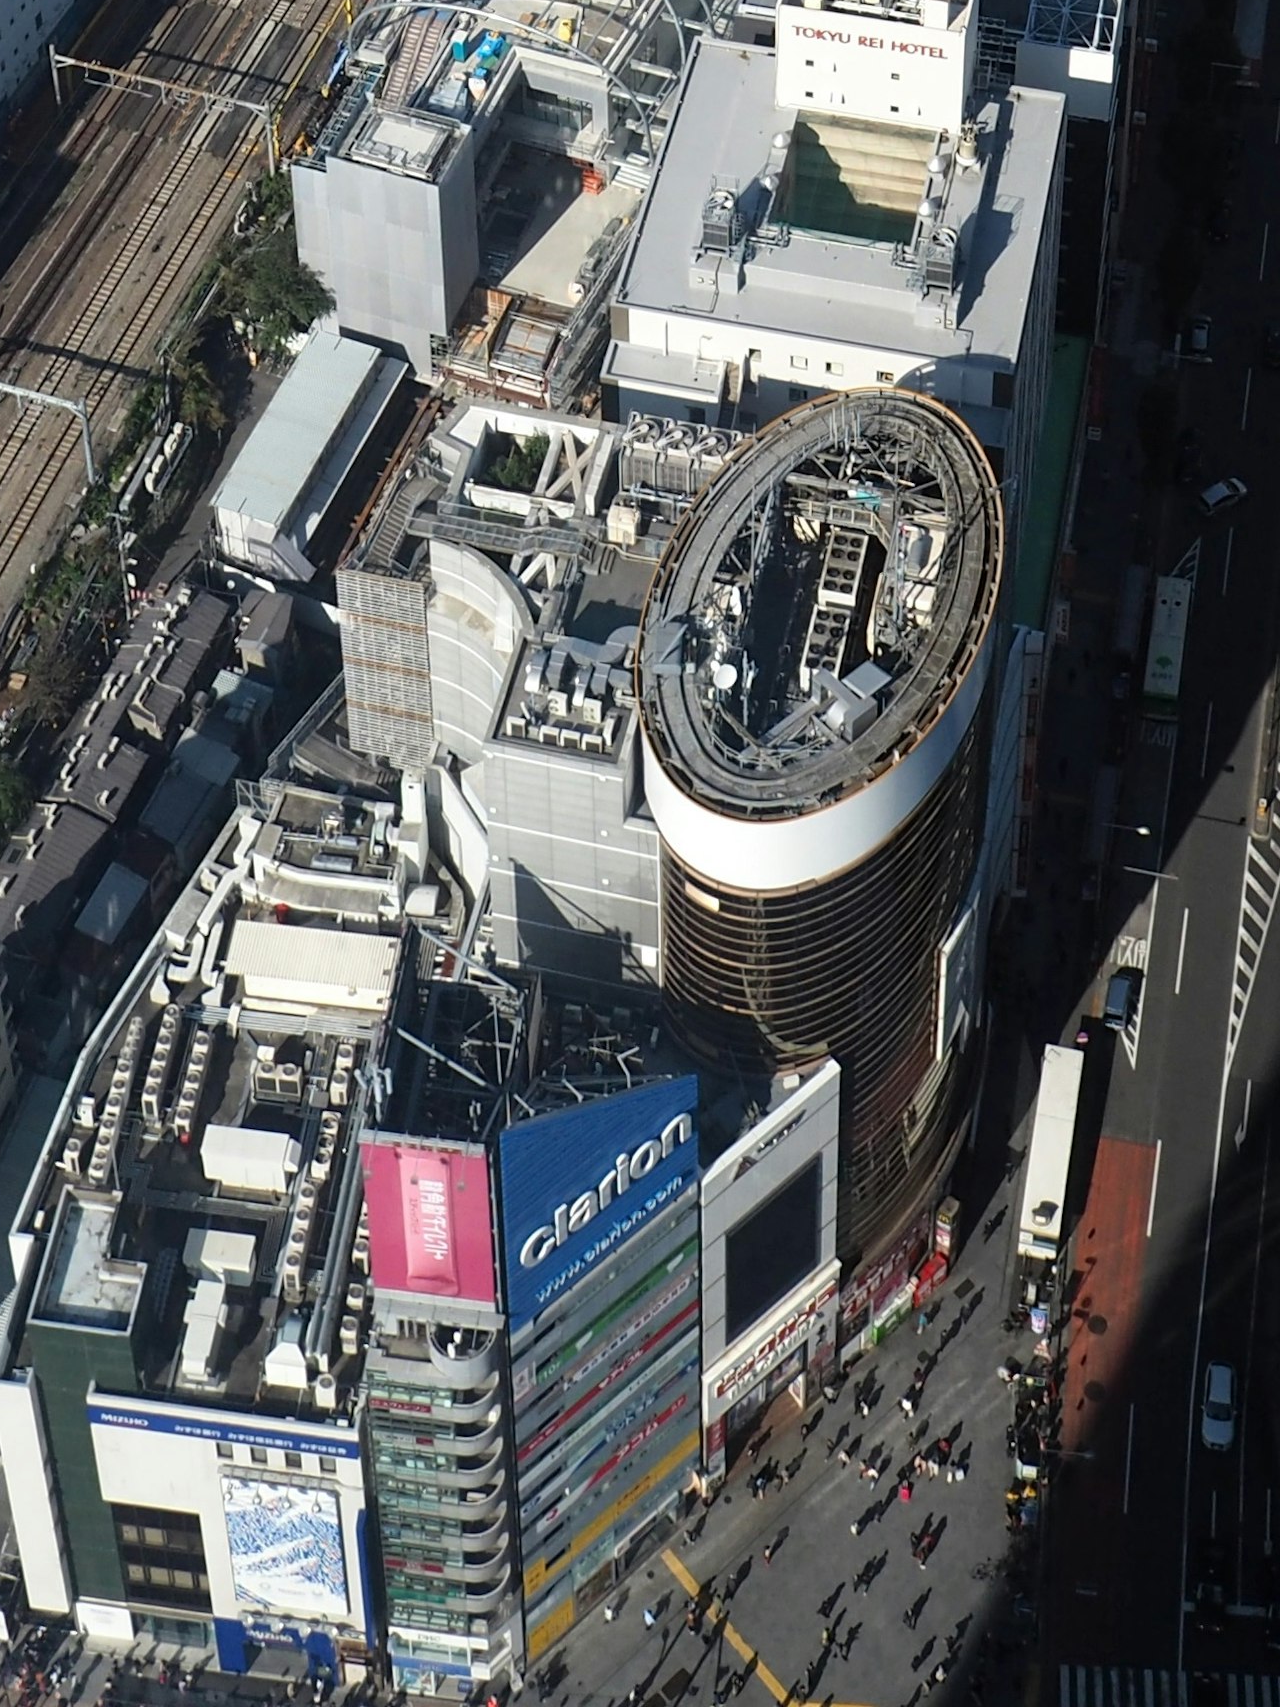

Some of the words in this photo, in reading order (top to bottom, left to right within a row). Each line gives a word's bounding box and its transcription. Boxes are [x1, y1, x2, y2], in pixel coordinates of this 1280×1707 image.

[792, 24, 852, 45] TOKYU
[858, 35, 884, 50] REI
[891, 40, 949, 60] HOTEL
[519, 1111, 693, 1269] clarion
[534, 1175, 685, 1304] www.clarion.com
[100, 1412, 150, 1427] MIZUHO
[617, 1420, 660, 1463] アコム
